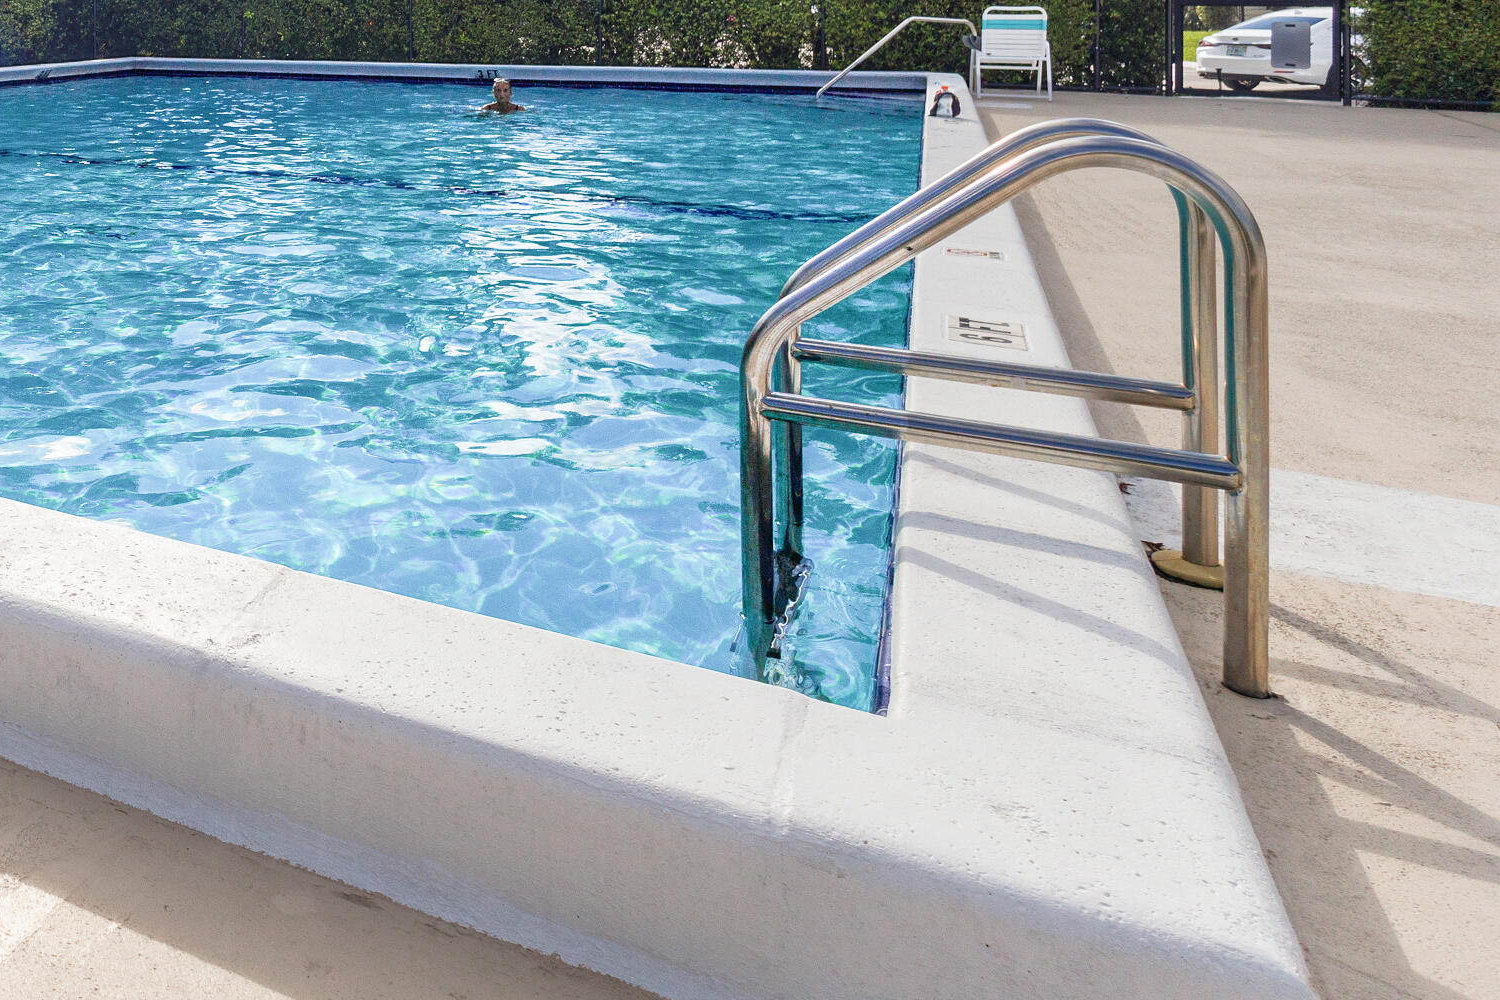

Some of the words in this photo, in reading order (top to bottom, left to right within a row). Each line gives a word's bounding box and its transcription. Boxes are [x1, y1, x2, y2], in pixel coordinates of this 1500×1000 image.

[477, 69, 484, 78] 3
[486, 69, 498, 79] FT
[958, 316, 1012, 334] FT
[959, 333, 1012, 343] 6
